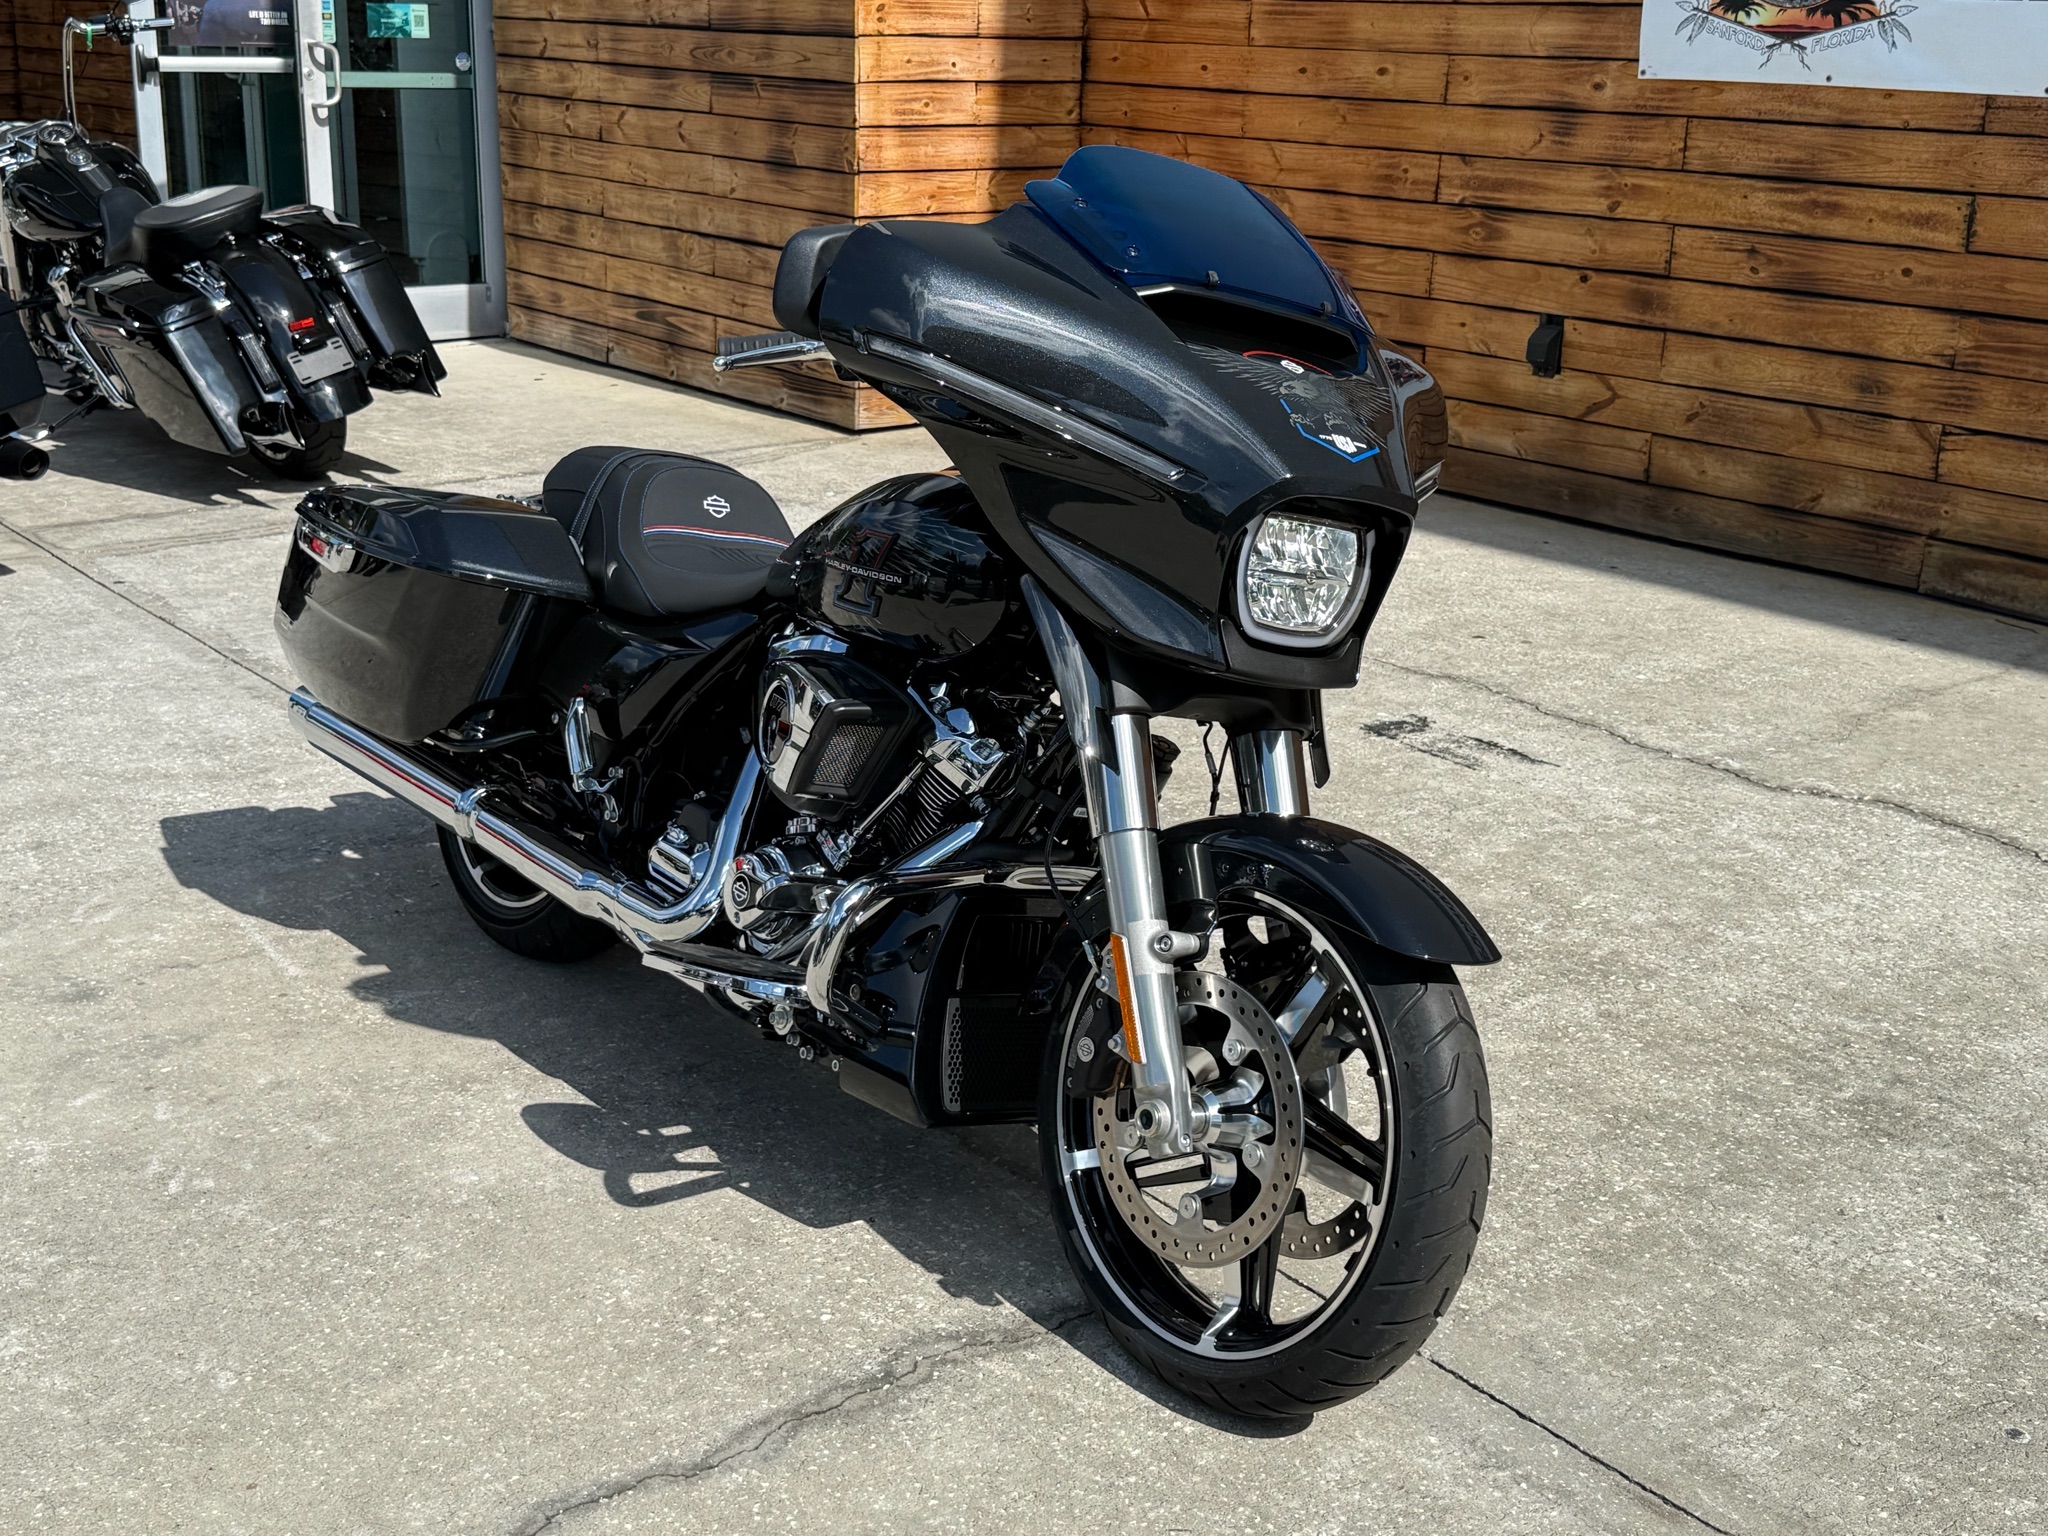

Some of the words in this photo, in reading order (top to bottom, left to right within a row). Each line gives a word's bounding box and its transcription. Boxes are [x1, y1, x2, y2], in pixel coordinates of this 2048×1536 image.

[1810, 23, 1875, 54] FLORIDA
[1331, 433, 1358, 454] USA
[824, 557, 903, 585] HARLEY-DAVIDSON
